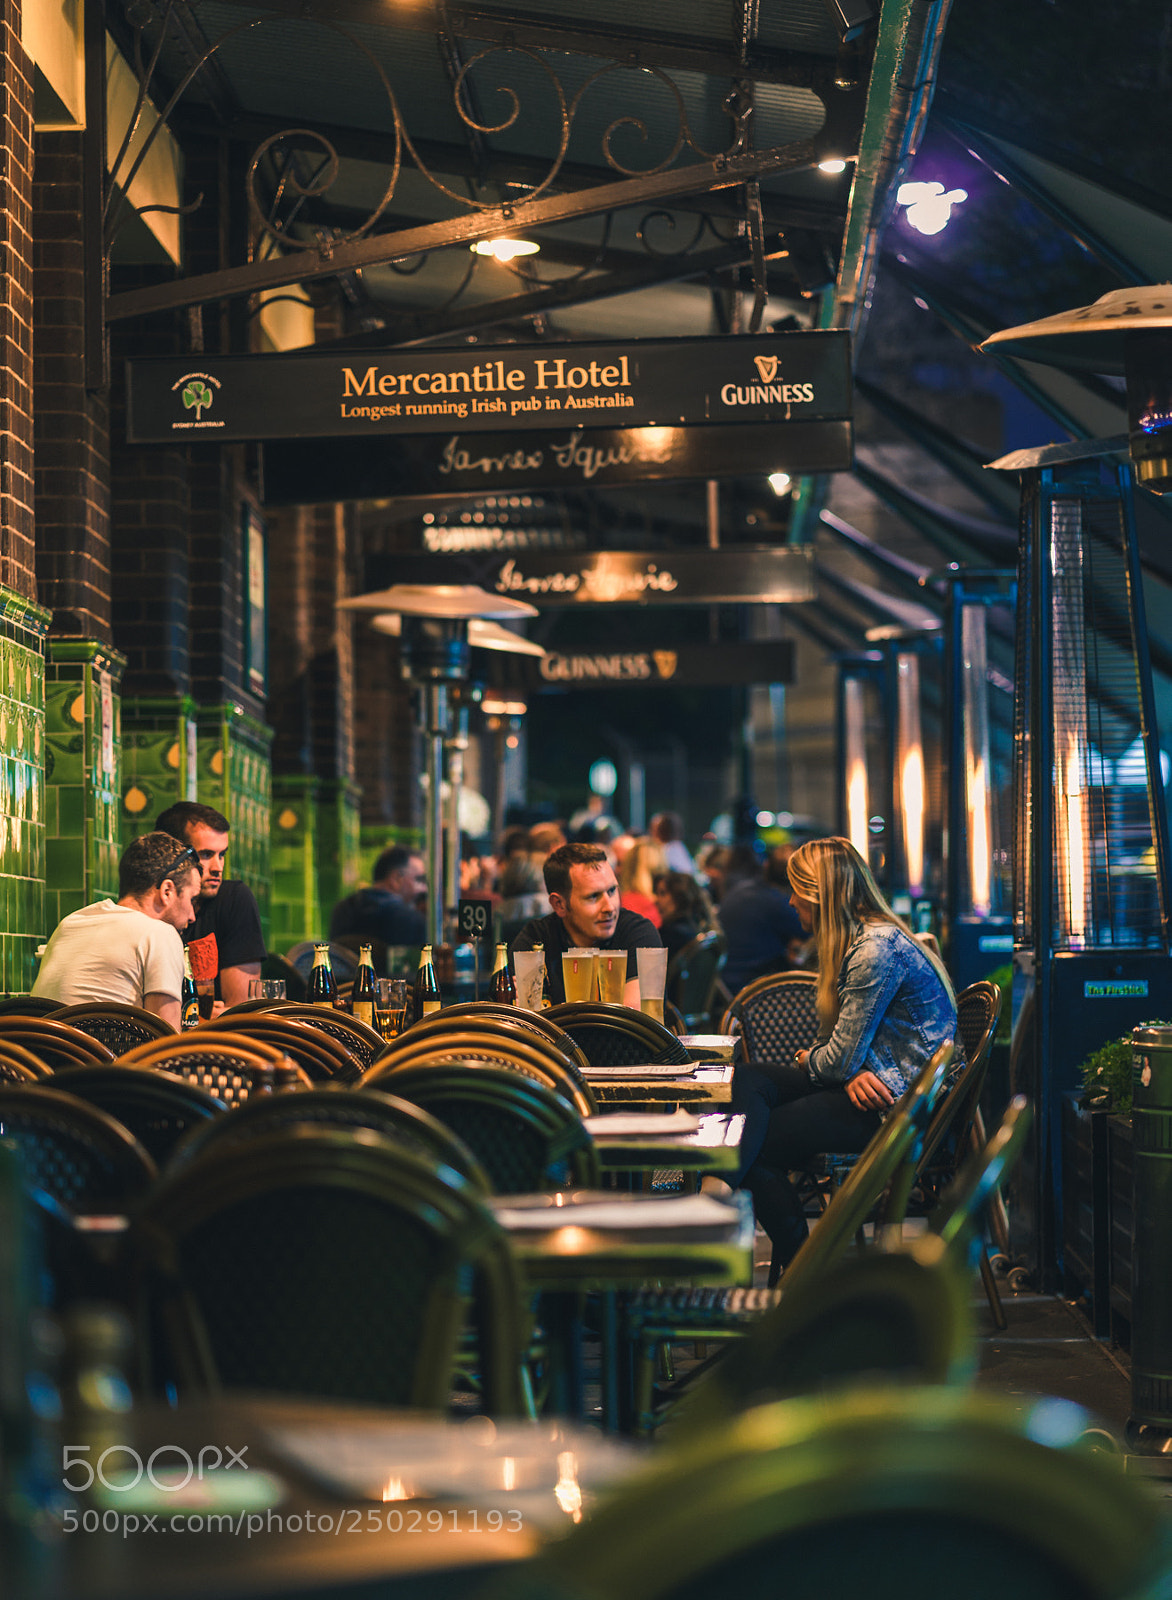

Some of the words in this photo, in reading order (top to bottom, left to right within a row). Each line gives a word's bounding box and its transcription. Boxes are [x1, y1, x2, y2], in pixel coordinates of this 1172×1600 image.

[341, 361, 526, 397] Mercantile
[533, 355, 632, 390] Hotel
[340, 402, 402, 421] Longest
[405, 400, 469, 418] running
[471, 396, 508, 413] Irish
[510, 395, 542, 416] pub
[545, 395, 561, 410] in
[564, 392, 635, 409] Australia
[721, 383, 815, 406] GUINNESS
[540, 653, 652, 681] GUINNESS
[463, 905, 487, 931] 39
